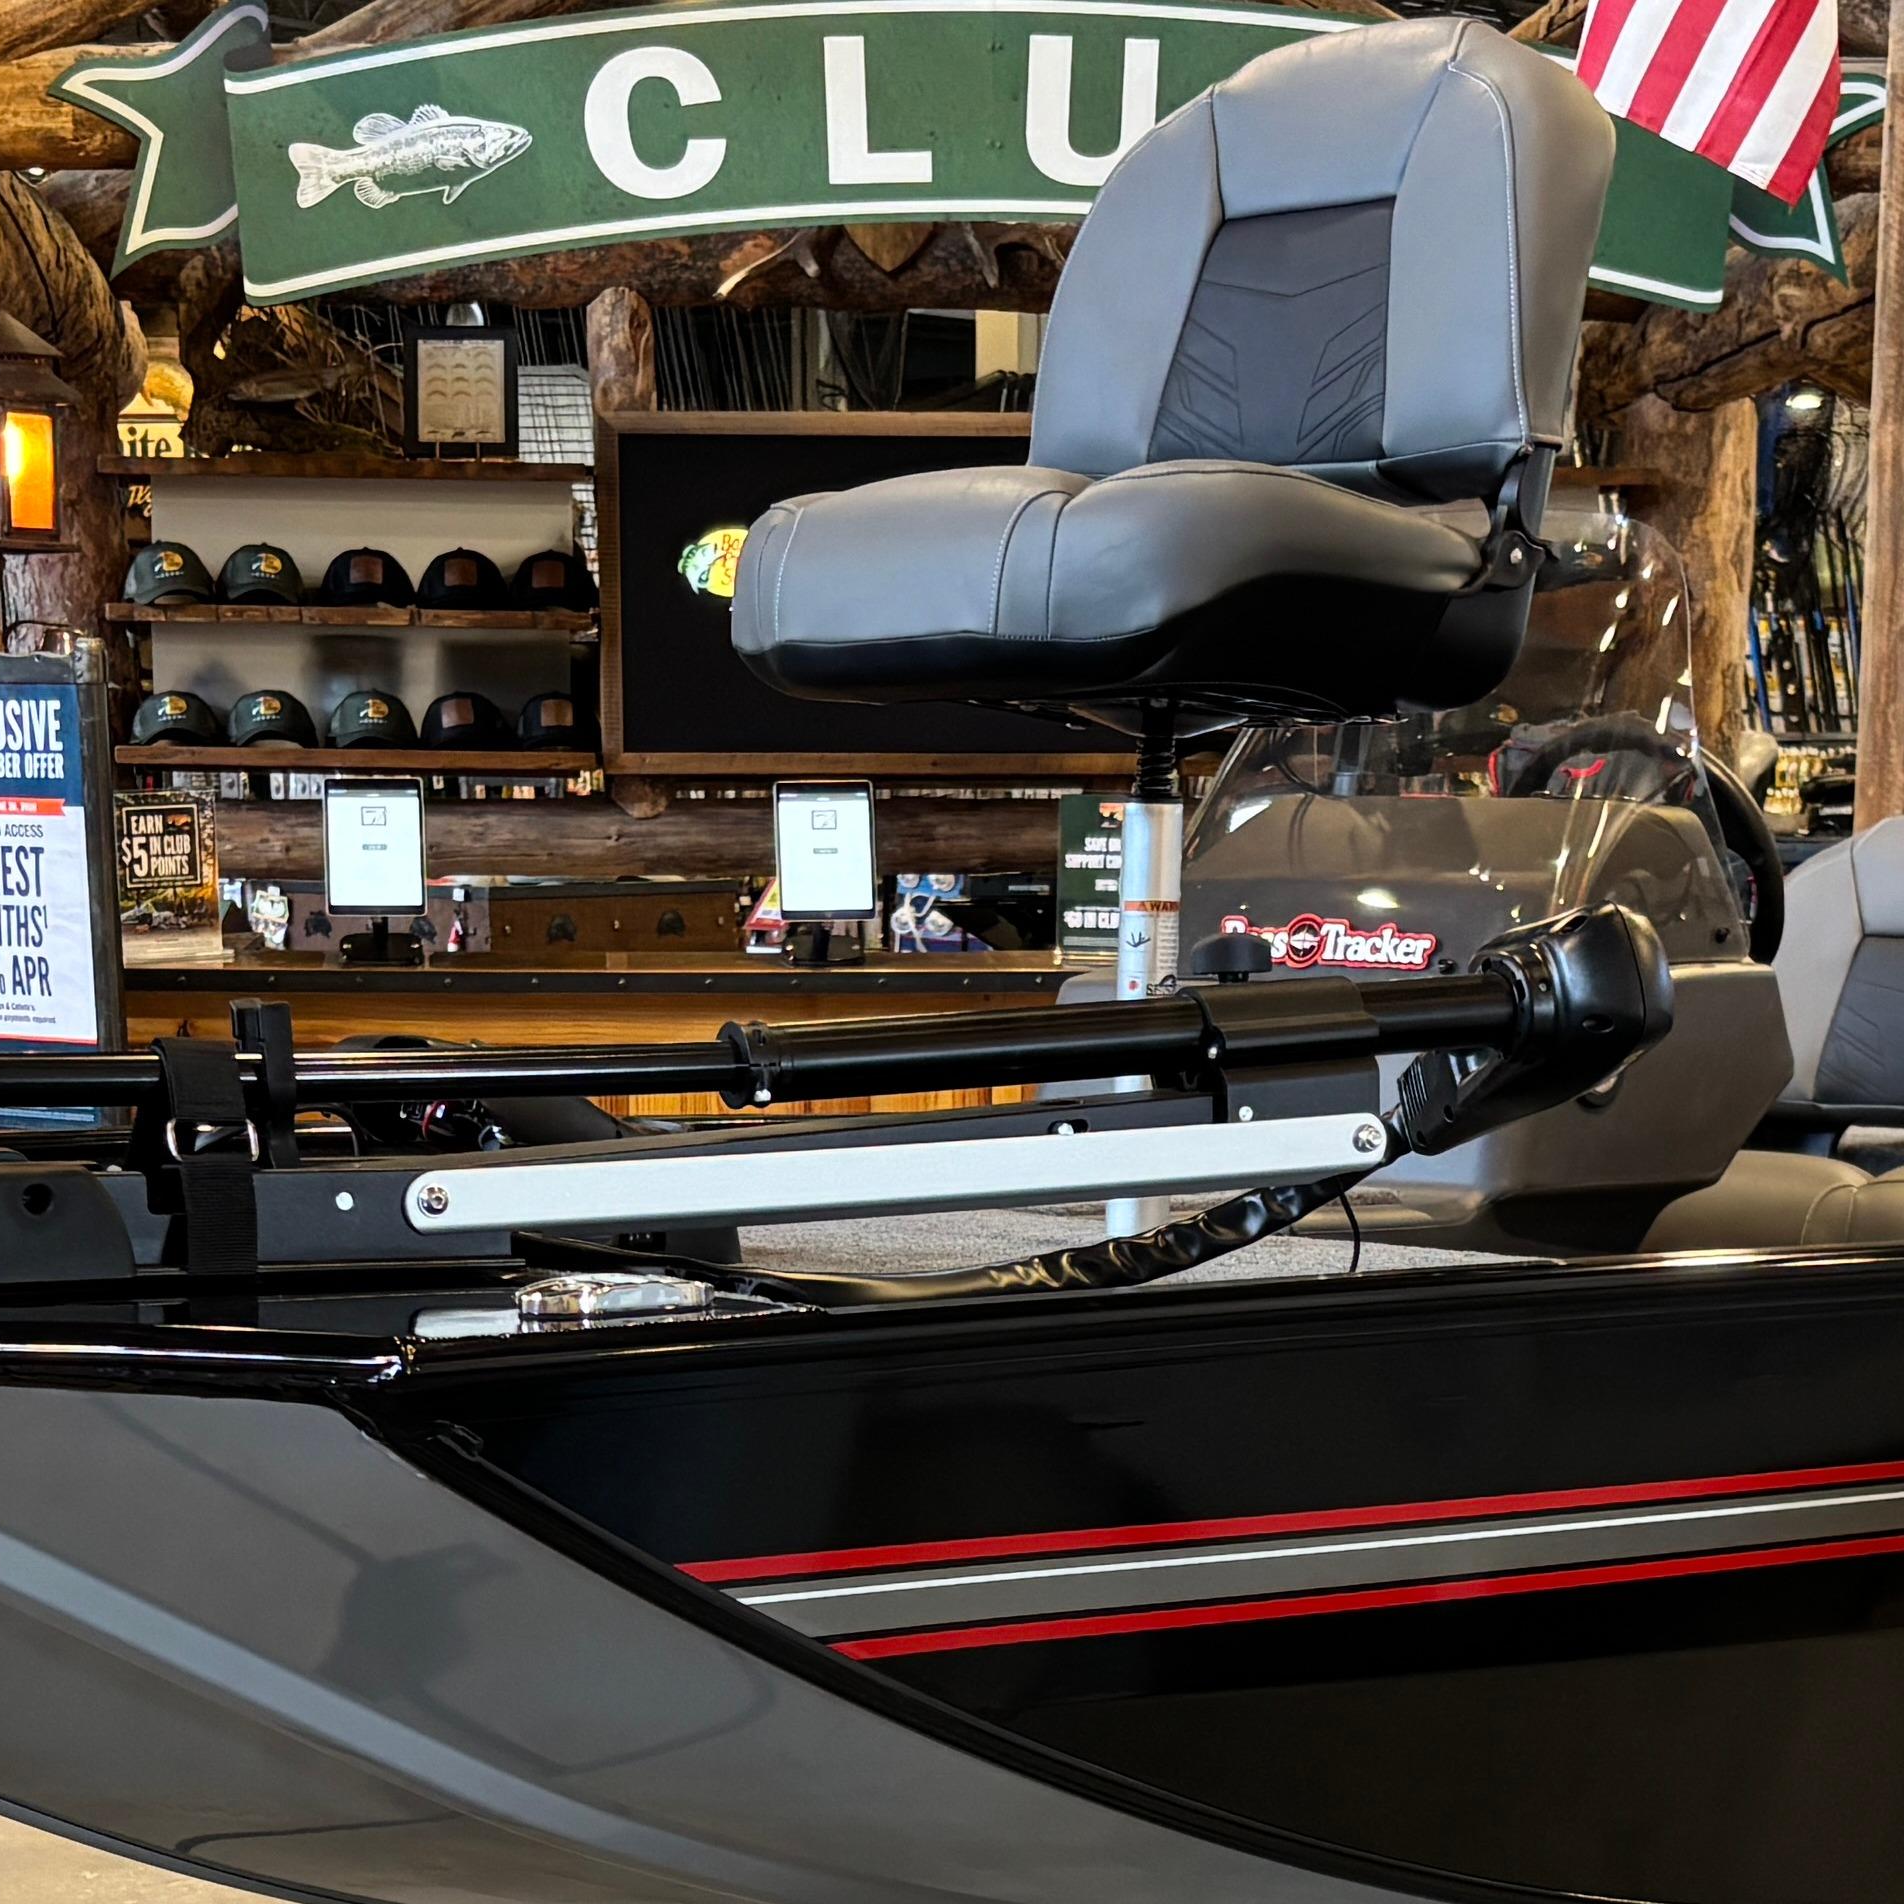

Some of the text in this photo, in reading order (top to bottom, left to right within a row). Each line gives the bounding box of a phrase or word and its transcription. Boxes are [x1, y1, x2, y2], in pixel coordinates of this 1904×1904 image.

[583, 34, 1162, 200] CLU
[24, 753, 65, 780] OFFER
[4, 824, 44, 838] ACCESS
[130, 814, 164, 835] EARN
[121, 833, 191, 877] $5 IN CLUB
[151, 855, 190, 877] POINTS
[1319, 922, 1433, 964] Tracker
[11, 955, 52, 997] APR
